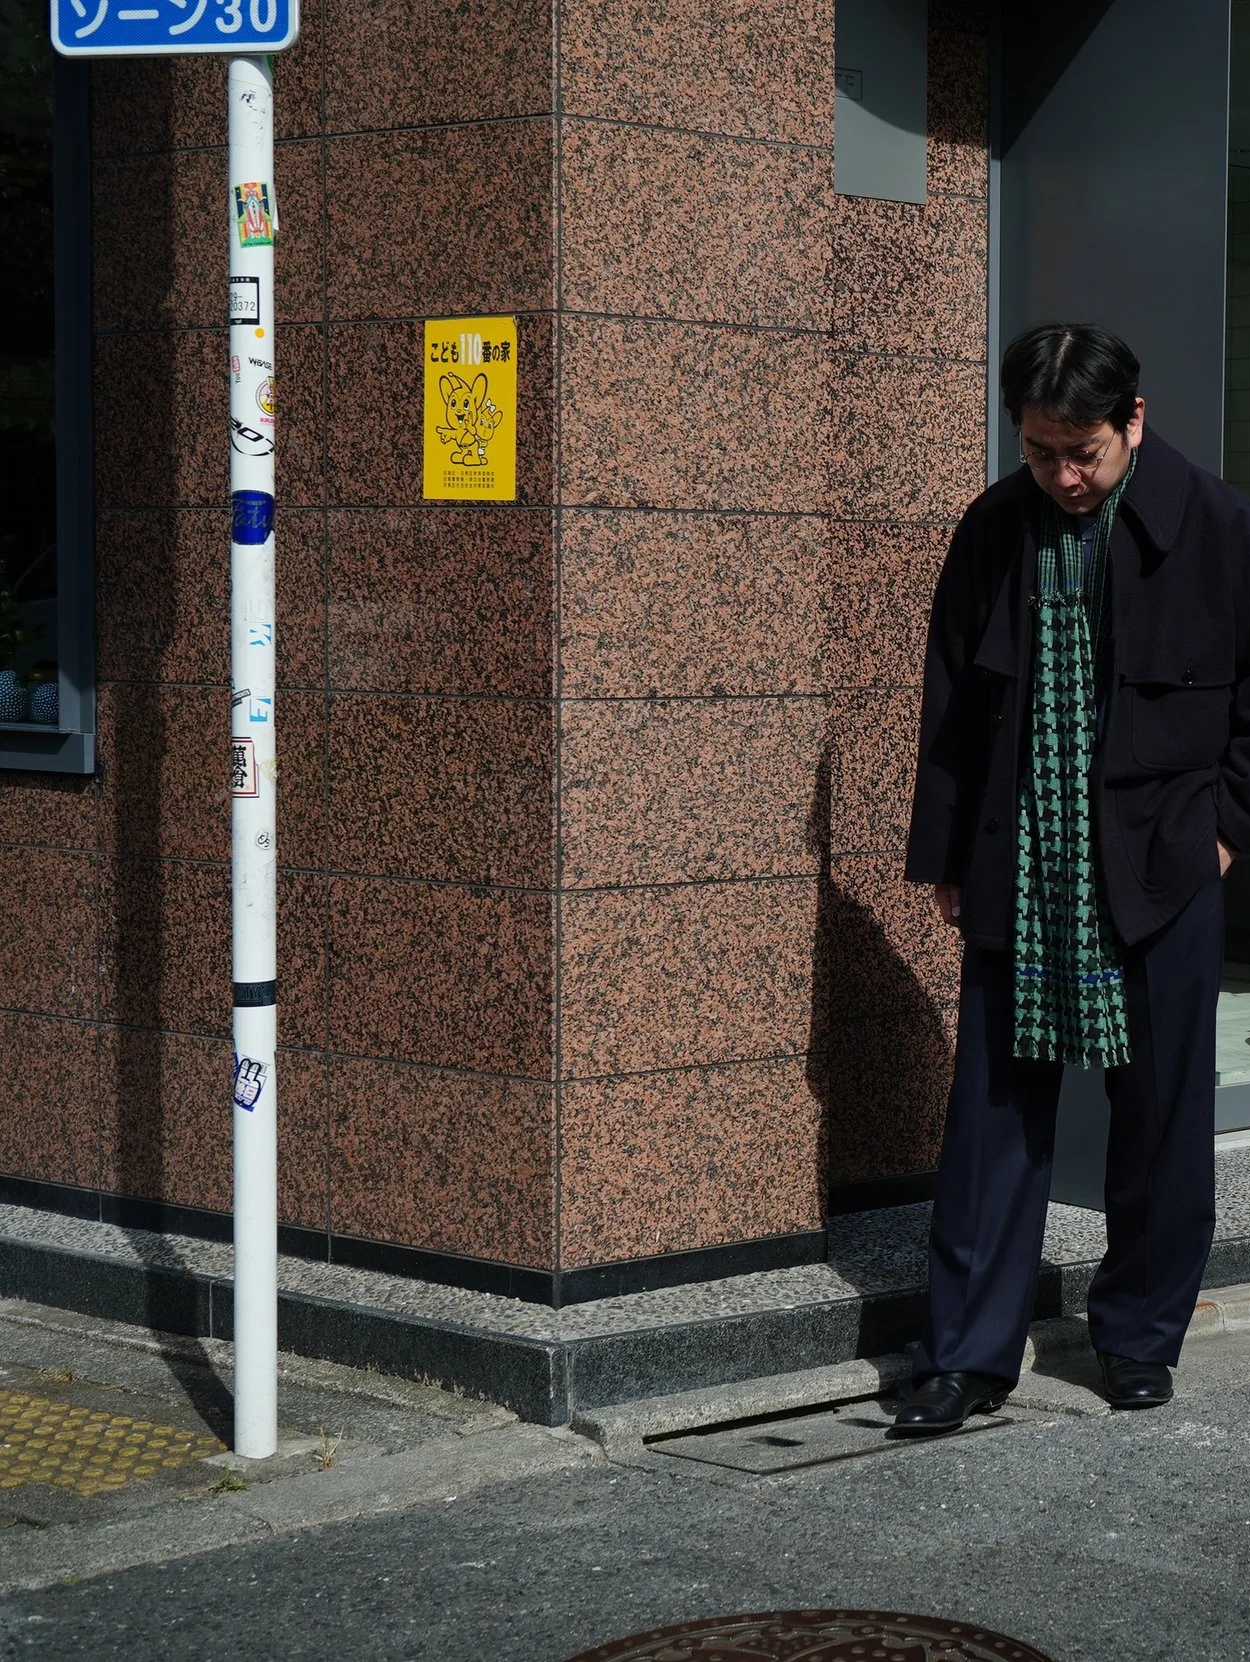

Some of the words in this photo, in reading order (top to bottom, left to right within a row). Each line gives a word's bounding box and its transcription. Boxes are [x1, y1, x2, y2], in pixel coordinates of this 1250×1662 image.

[430, 332, 511, 365] こども110番の家
